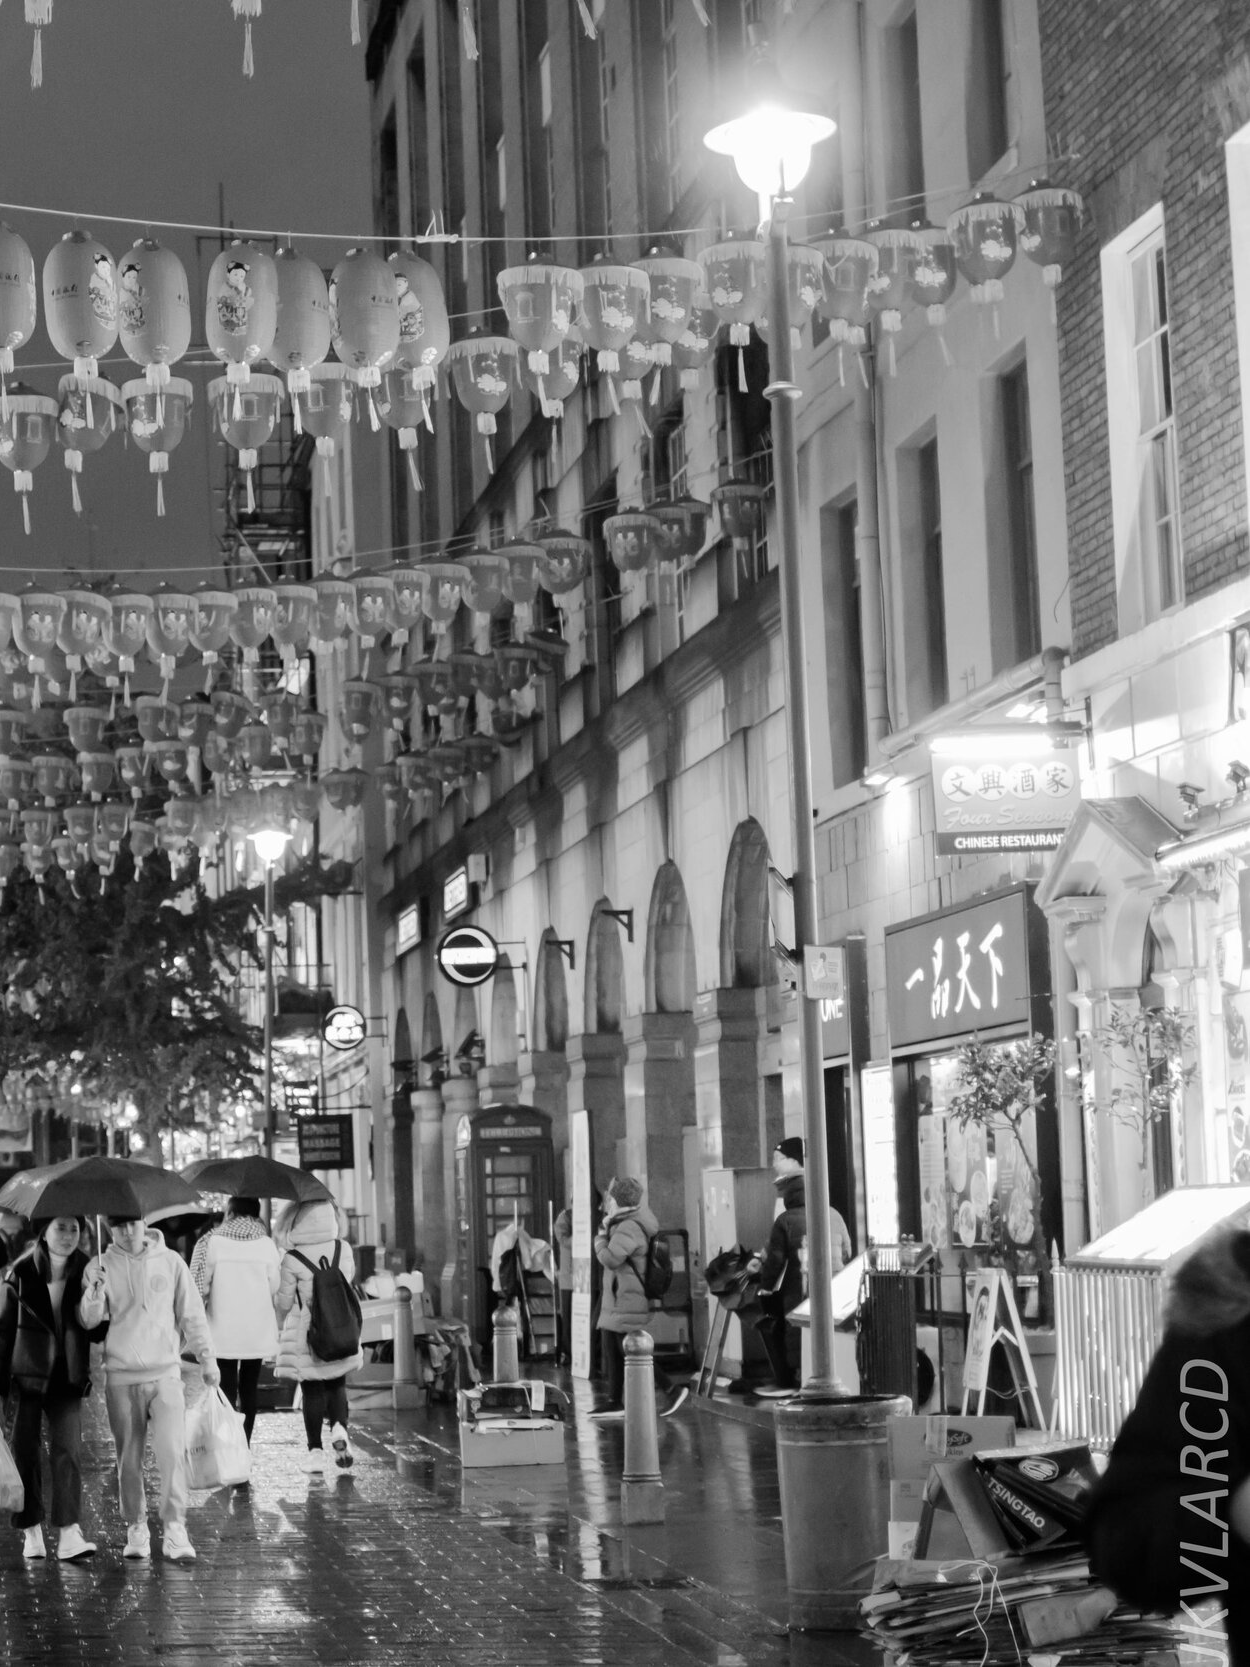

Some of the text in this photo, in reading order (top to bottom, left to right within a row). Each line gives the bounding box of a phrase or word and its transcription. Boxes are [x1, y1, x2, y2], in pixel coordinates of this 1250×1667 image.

[946, 765, 1070, 797] 文興酒家
[941, 804, 993, 830] Four
[953, 834, 1000, 850] CHINESE
[904, 921, 1003, 1020] 一品天下
[988, 1476, 1046, 1529] TSINGTAO
